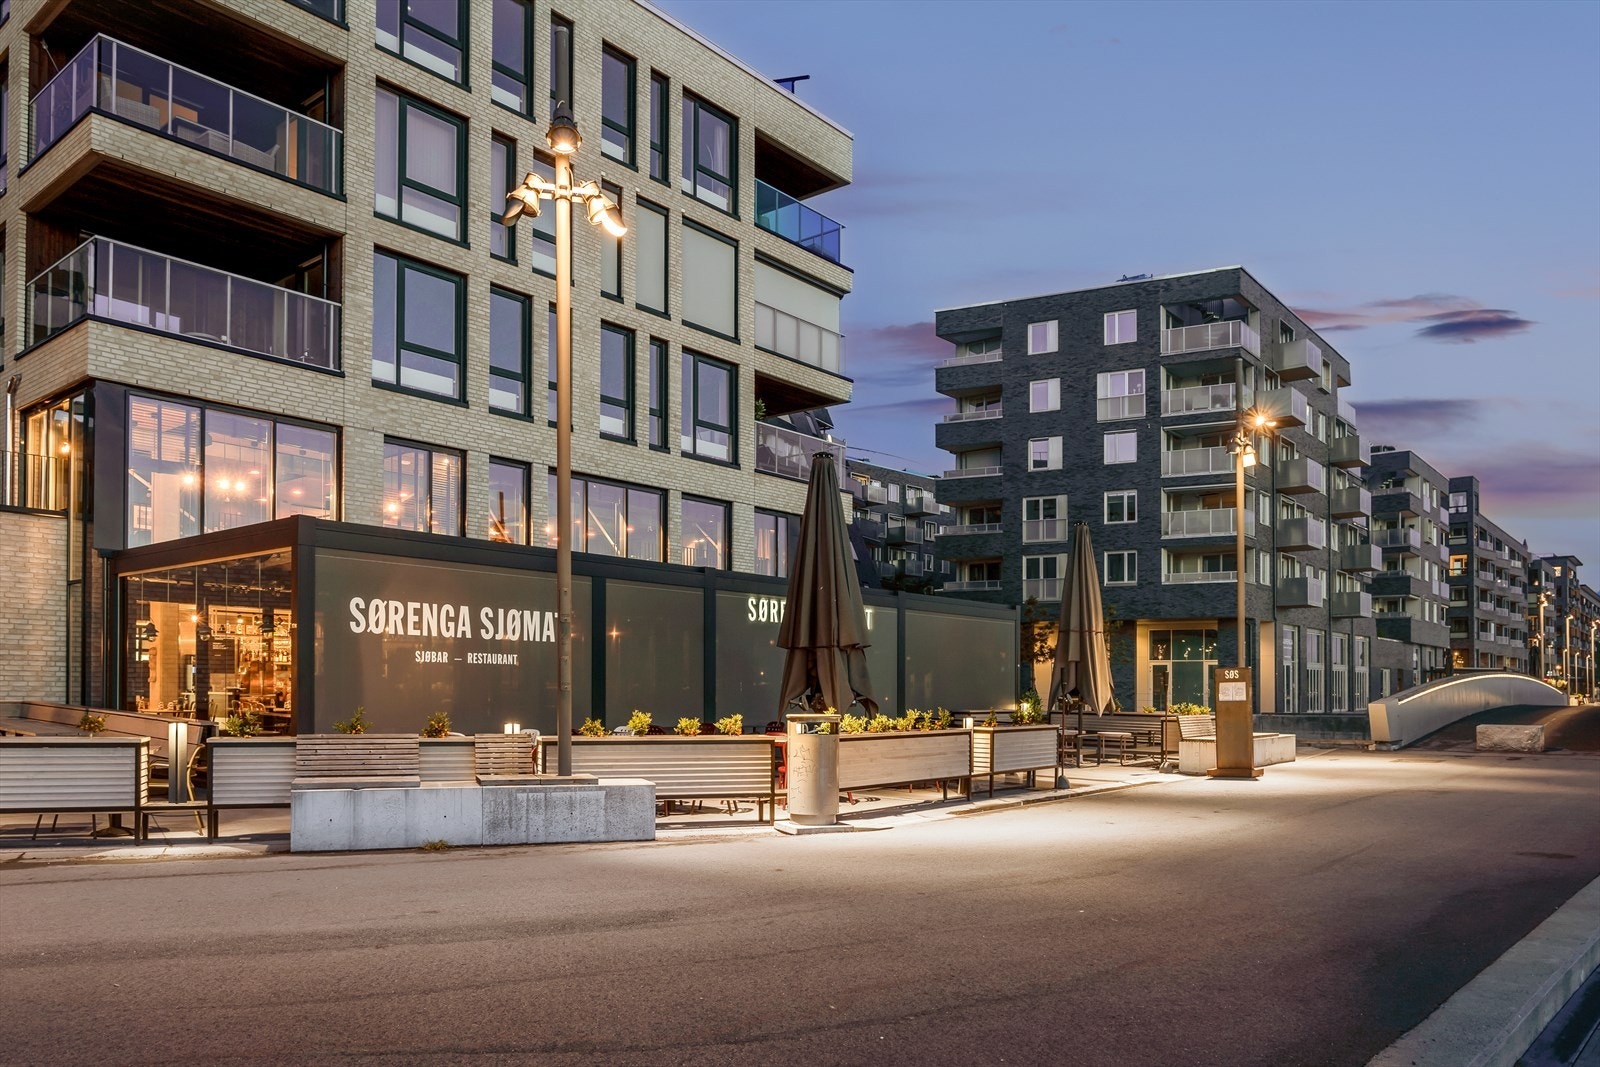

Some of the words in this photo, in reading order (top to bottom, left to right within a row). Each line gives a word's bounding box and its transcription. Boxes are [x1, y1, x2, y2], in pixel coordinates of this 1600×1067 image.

[349, 597, 472, 639] SØRENGA
[480, 606, 558, 642] SJØMA
[415, 650, 448, 663] SJØBAR
[467, 652, 518, 665] RESTAURANT
[1224, 670, 1239, 679] SØS
